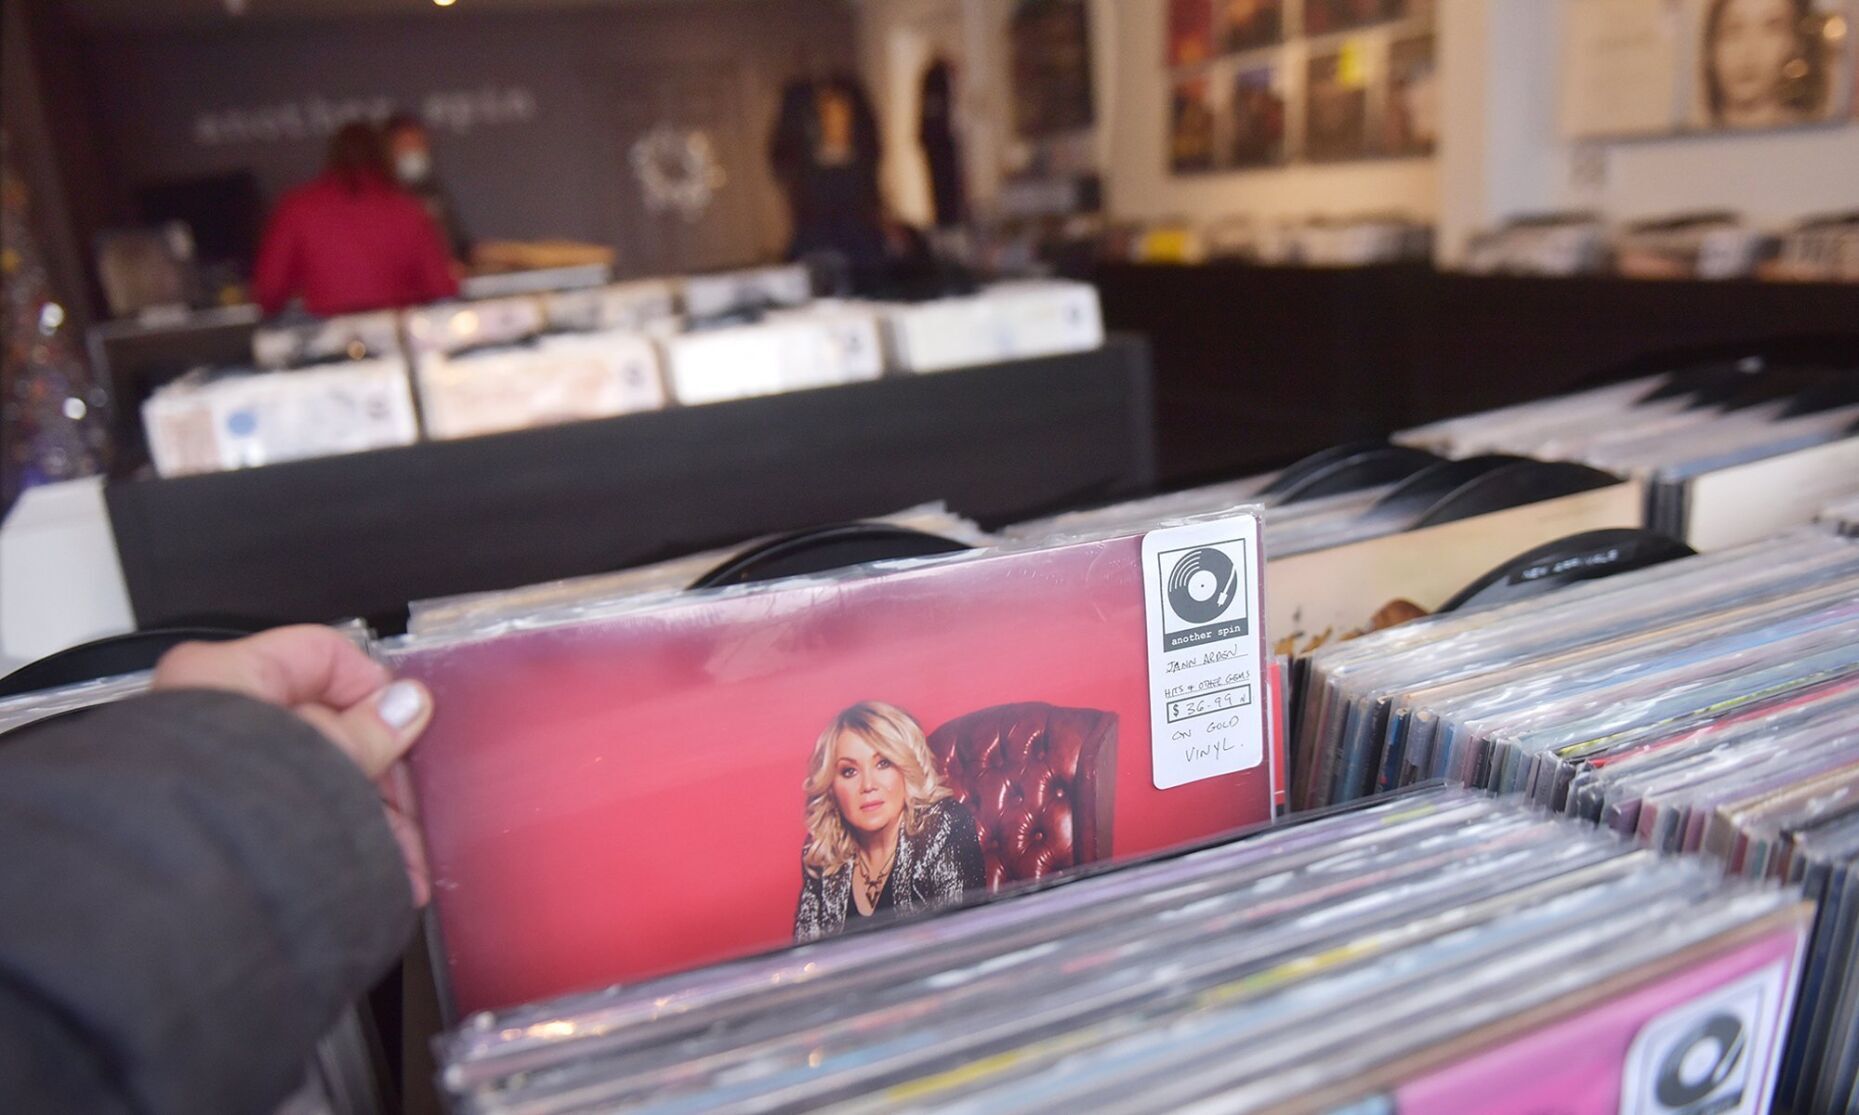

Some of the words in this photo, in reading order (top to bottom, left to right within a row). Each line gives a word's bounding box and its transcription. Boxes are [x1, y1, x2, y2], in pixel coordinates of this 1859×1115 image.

[1171, 630, 1213, 646] another
[1217, 625, 1241, 637] spin
[1166, 657, 1197, 673] JANN
[1202, 643, 1238, 665] ARDEN
[1164, 684, 1184, 699] HITS
[1225, 670, 1251, 684] GEMS
[1172, 703, 1180, 717] $
[1171, 729, 1192, 741] ON
[1206, 715, 1240, 733] GOLD
